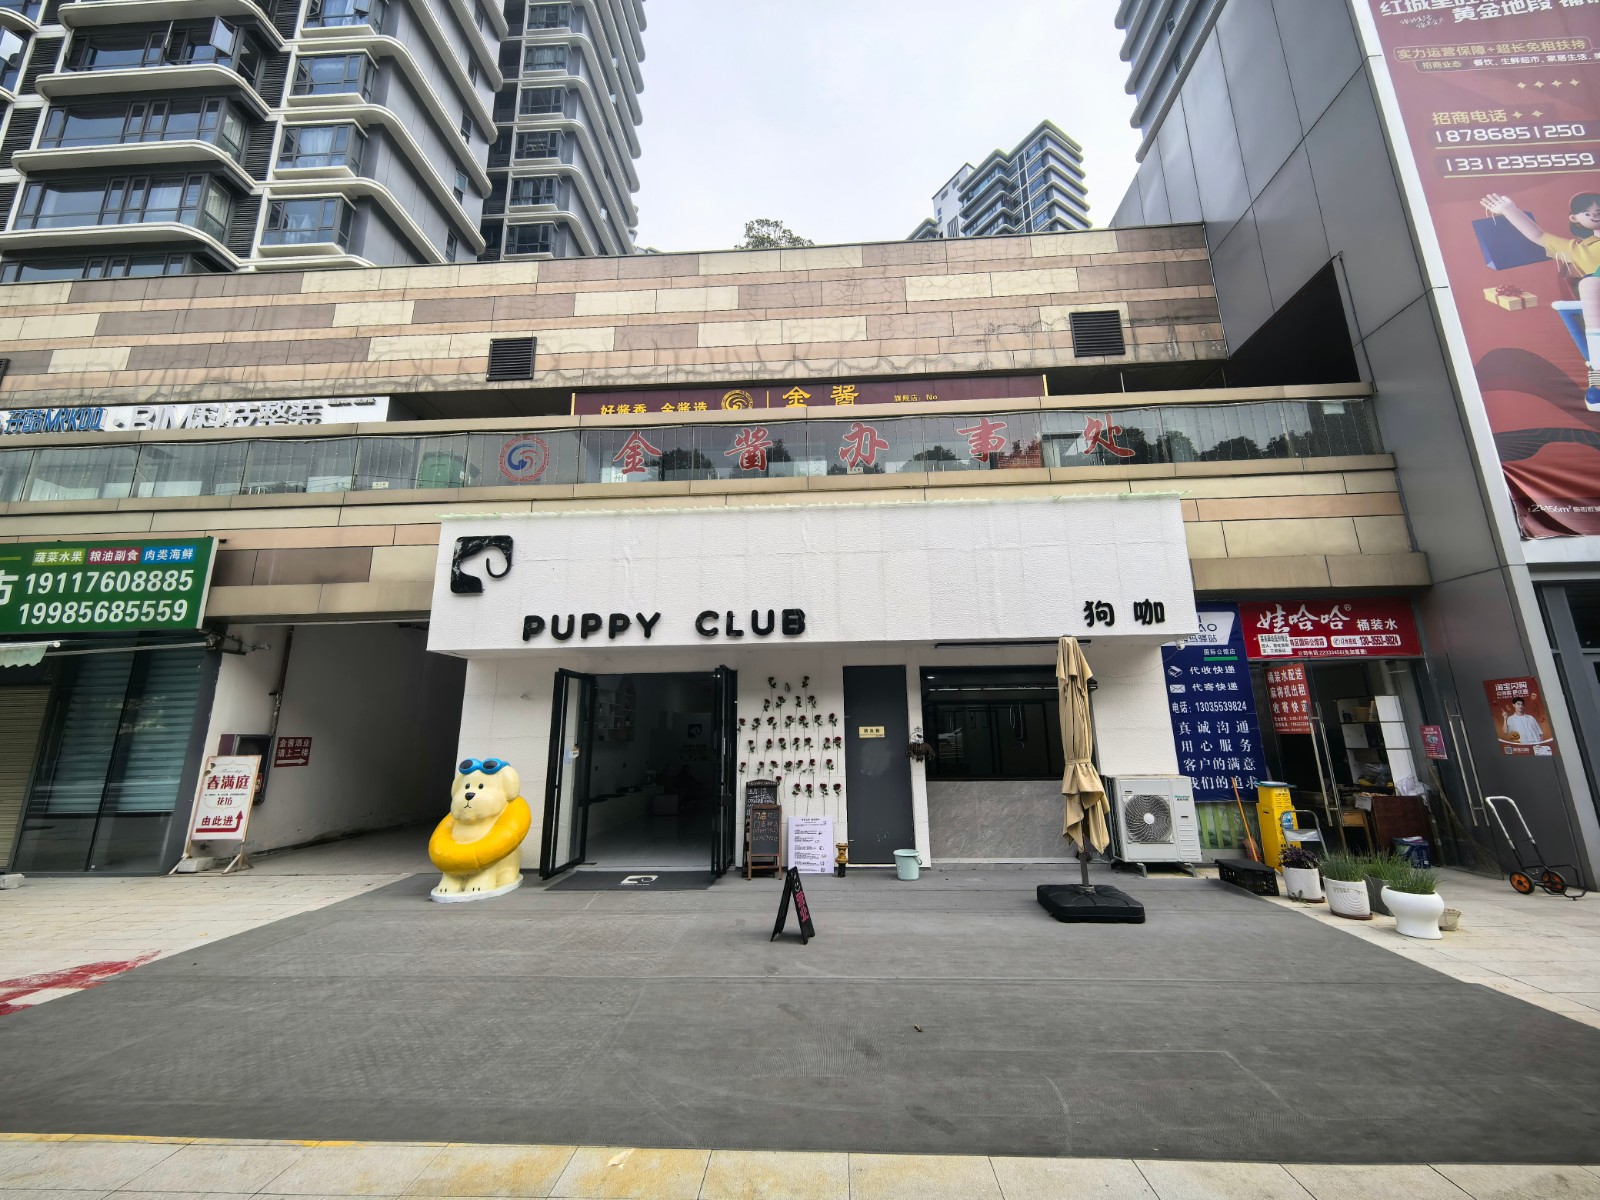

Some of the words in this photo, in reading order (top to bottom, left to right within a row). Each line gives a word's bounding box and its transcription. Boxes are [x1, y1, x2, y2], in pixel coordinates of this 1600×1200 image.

[1452, 0, 1552, 23] 黄金地段
[1432, 109, 1507, 126] 招商电话
[1435, 123, 1586, 143] 18786851250
[1446, 152, 1596, 172] 13312355559
[782, 384, 860, 408] 金酱
[612, 412, 1136, 475] 金酱办事处
[34, 550, 84, 563] 蔬菜水果
[89, 549, 139, 562] 粮油副食
[144, 548, 194, 561] 肉类海鲜
[25, 570, 194, 595] 19117608885
[19, 599, 188, 625] 19985685559
[1083, 599, 1166, 627] 狗咖
[1256, 603, 1350, 633] 娃哈哈
[1356, 618, 1398, 631] 桶装水
[522, 611, 662, 641] PUPPY
[695, 608, 806, 637] CLUB
[1189, 665, 1236, 675] 代收快递
[1192, 682, 1239, 692] 代寄快递
[1195, 701, 1247, 712] 13035539824
[1179, 720, 1250, 735] 真诚沟通
[1181, 738, 1252, 752] 用心服务
[1183, 757, 1256, 772] 客户的满意
[202, 816, 233, 826] 由此进
